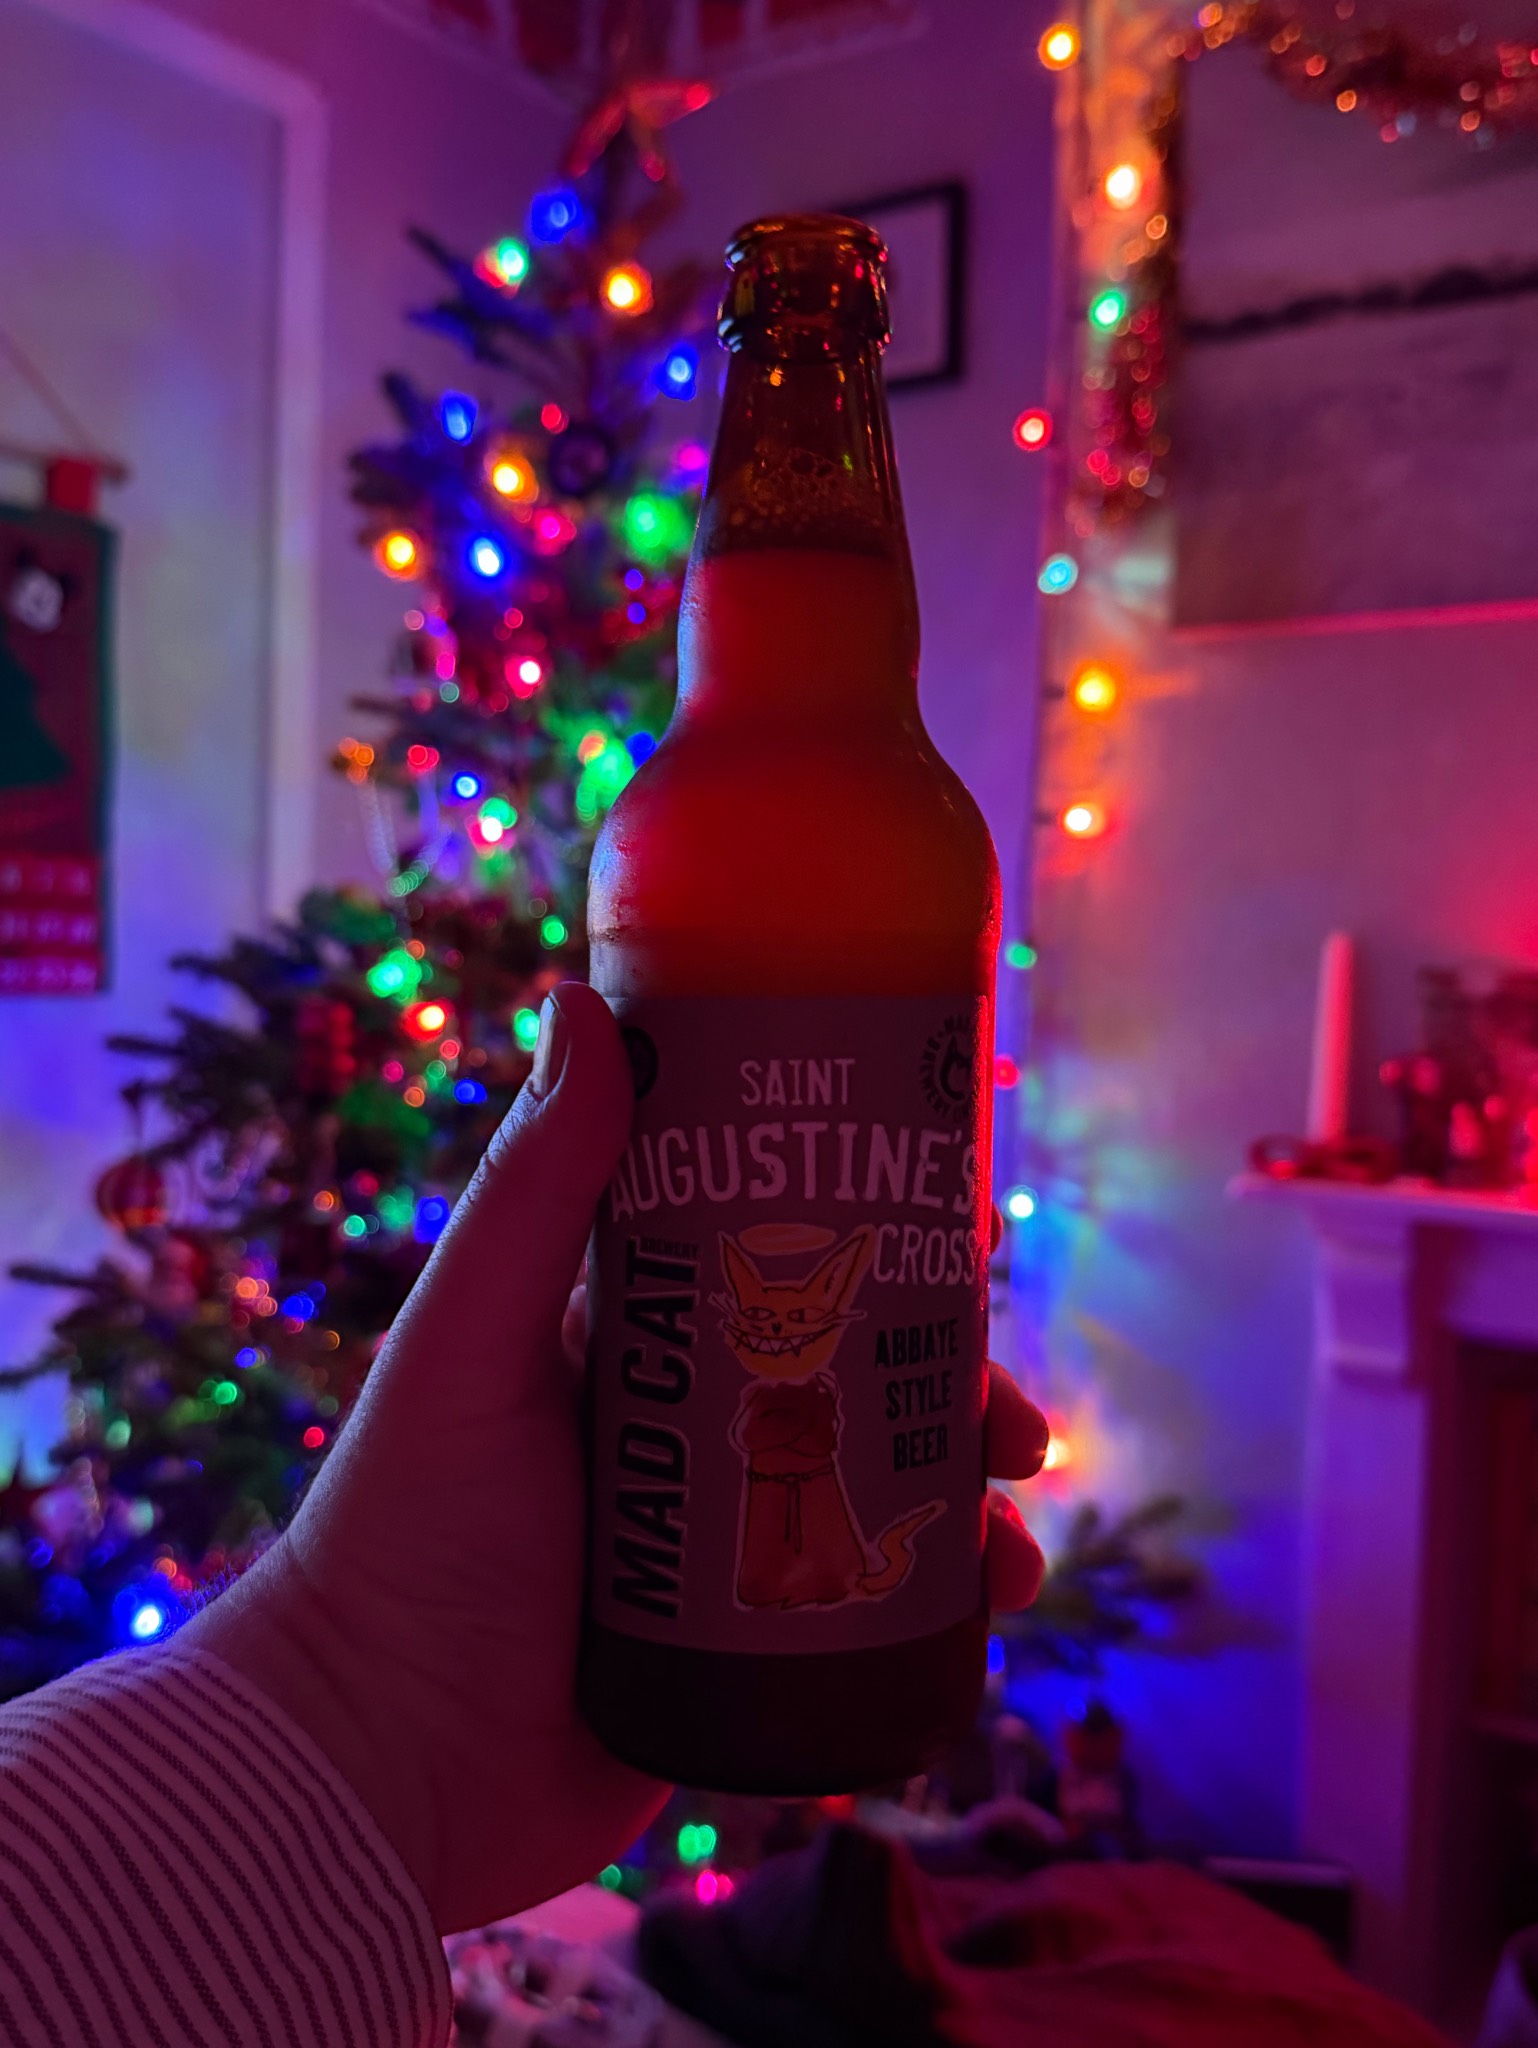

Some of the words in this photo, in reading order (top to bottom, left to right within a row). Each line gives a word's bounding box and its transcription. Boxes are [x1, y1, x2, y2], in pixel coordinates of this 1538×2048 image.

[740, 1058, 856, 1107] SAINT
[640, 1236, 699, 1260] BREWERY
[873, 1223, 977, 1286] CROSS
[620, 1234, 701, 1406] CAT
[875, 1318, 959, 1369] ABBAYE
[885, 1370, 953, 1421] STYLE
[893, 1424, 949, 1473] BEER
[611, 1422, 692, 1620] MAD
